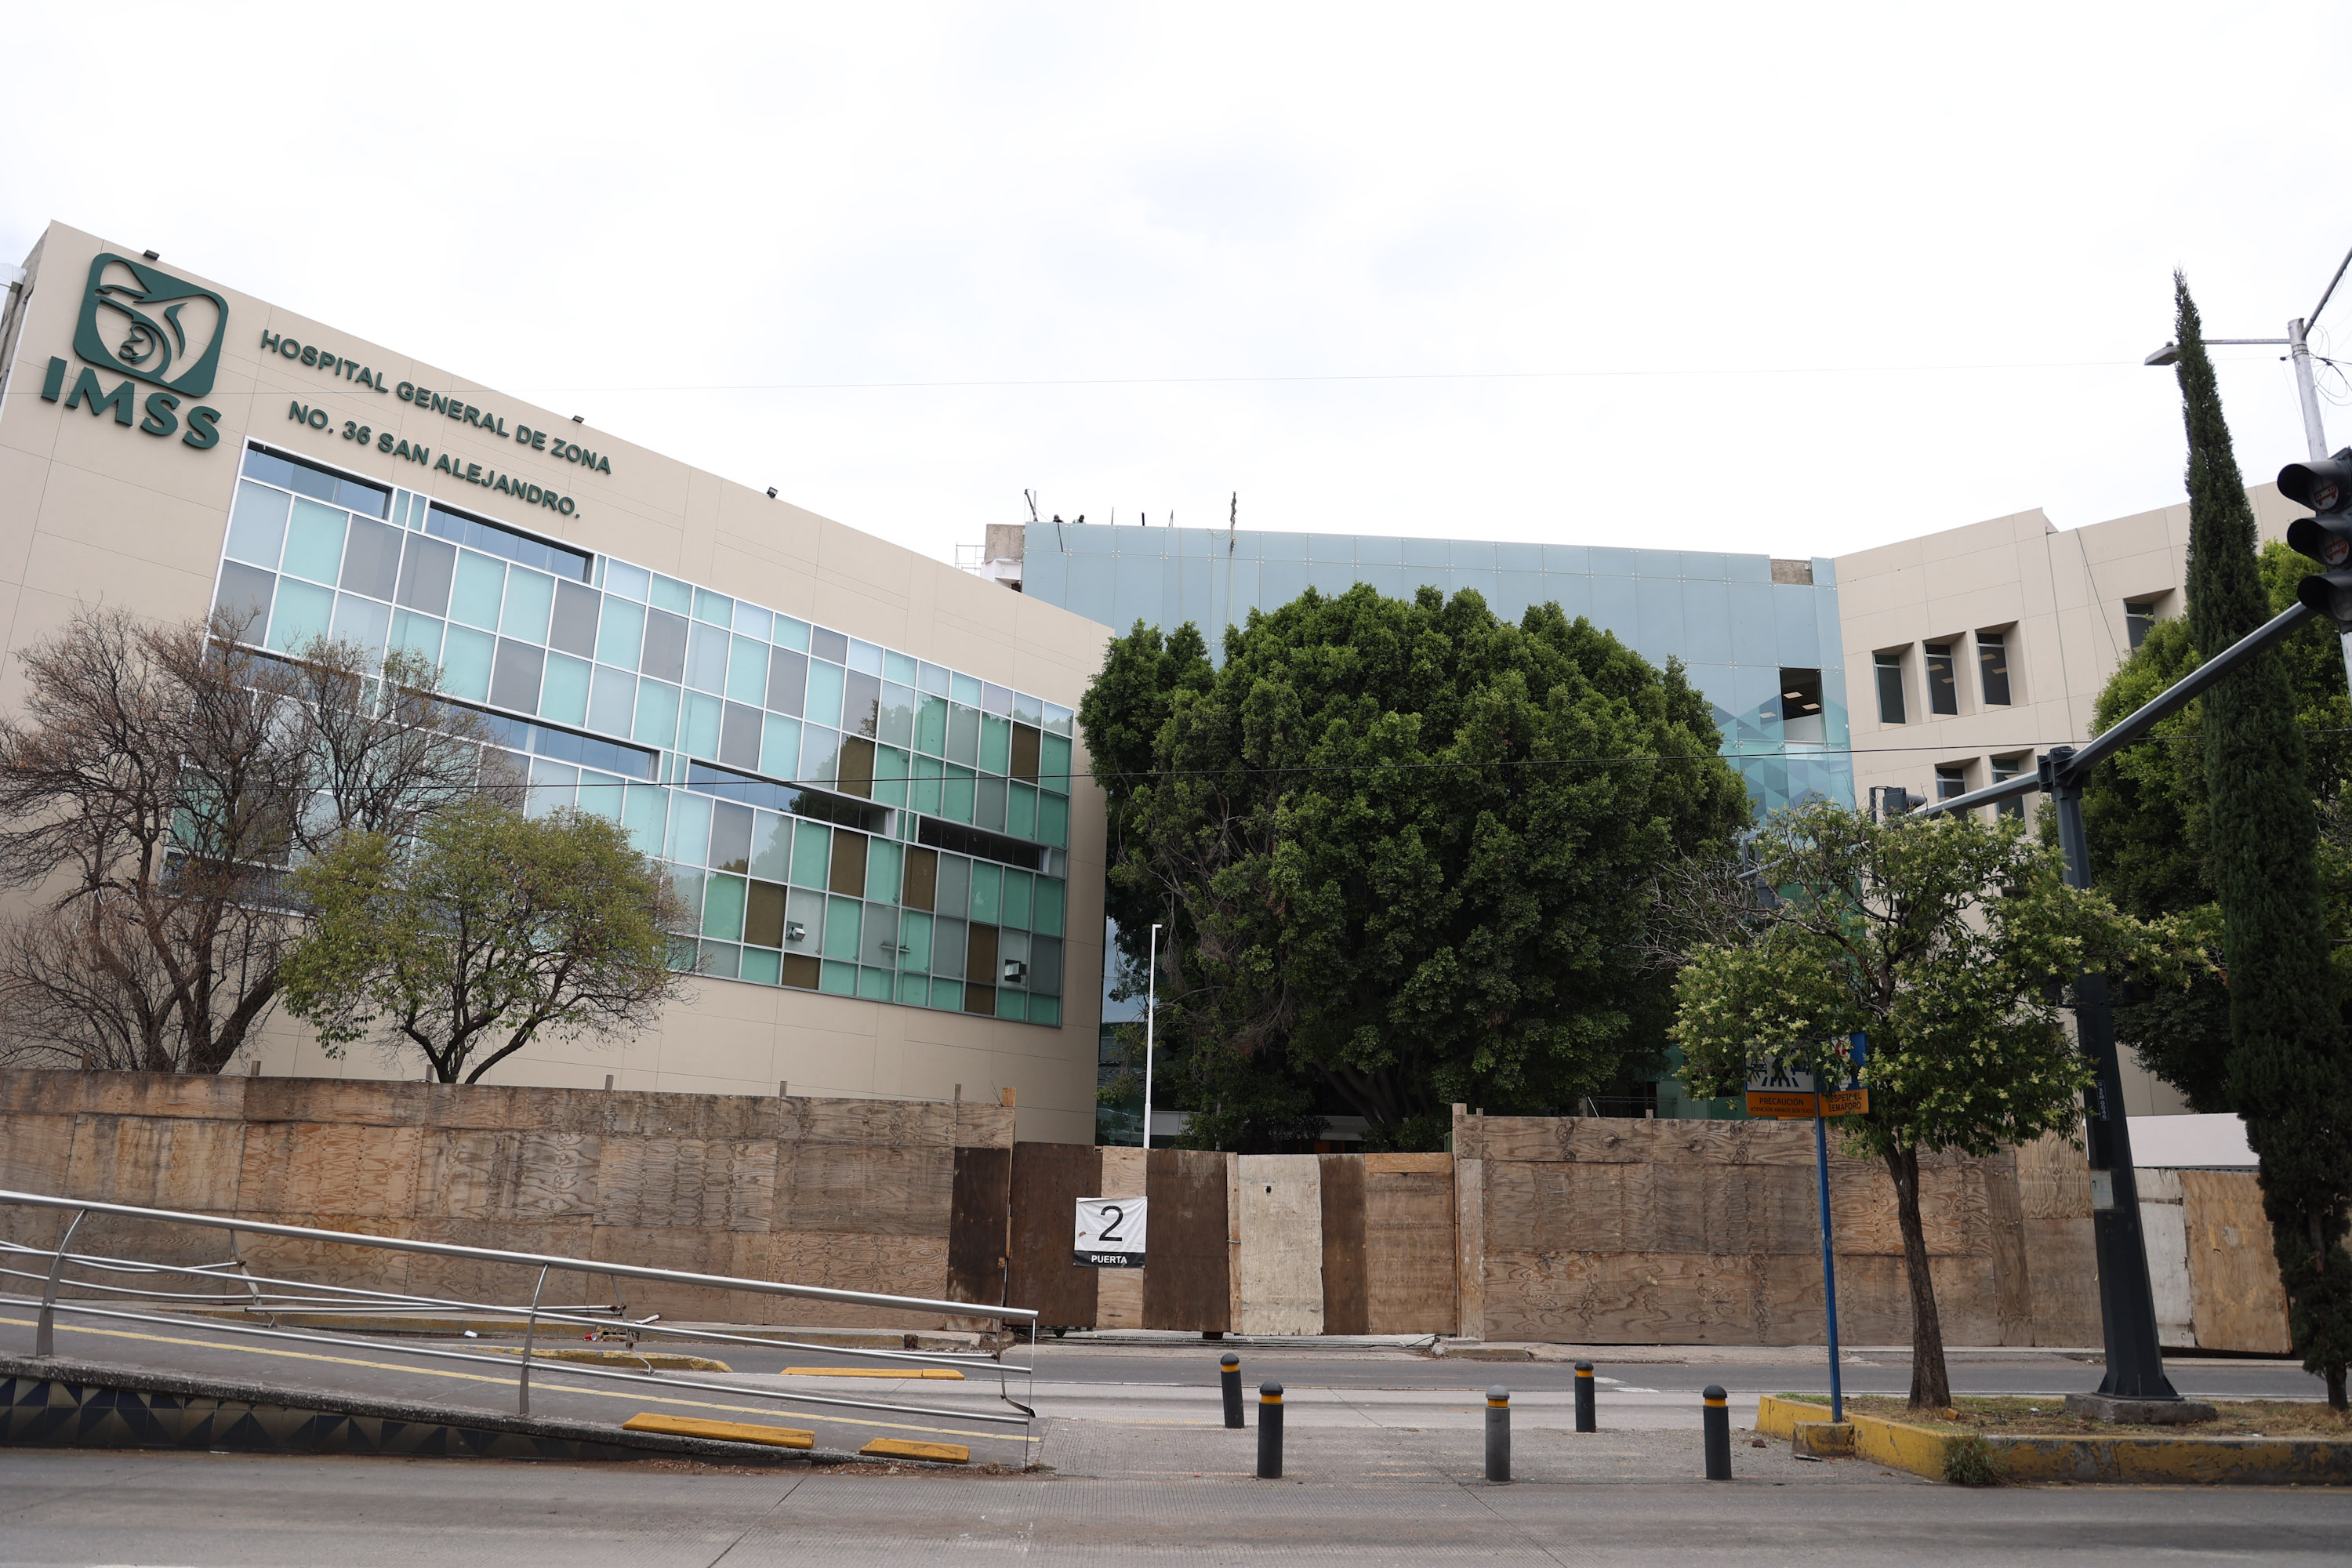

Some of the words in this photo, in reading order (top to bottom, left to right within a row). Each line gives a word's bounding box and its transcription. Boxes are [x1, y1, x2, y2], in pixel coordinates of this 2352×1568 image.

[40, 355, 223, 449] IMSS
[260, 329, 390, 394] HOSPITAL
[397, 381, 510, 437] GENERAL
[516, 423, 547, 449] DE
[550, 436, 612, 475] ZONA
[289, 400, 335, 434] NO.
[343, 419, 372, 445] 36
[377, 431, 430, 465] SAN
[434, 453, 581, 519] ALEJANDRO.
[1759, 1097, 1804, 1106] PRECAUCIÓN
[1828, 1101, 1862, 1112] SEMÁFORO
[1098, 1205, 1123, 1241] 2
[1091, 1255, 1127, 1264] PUERTA
